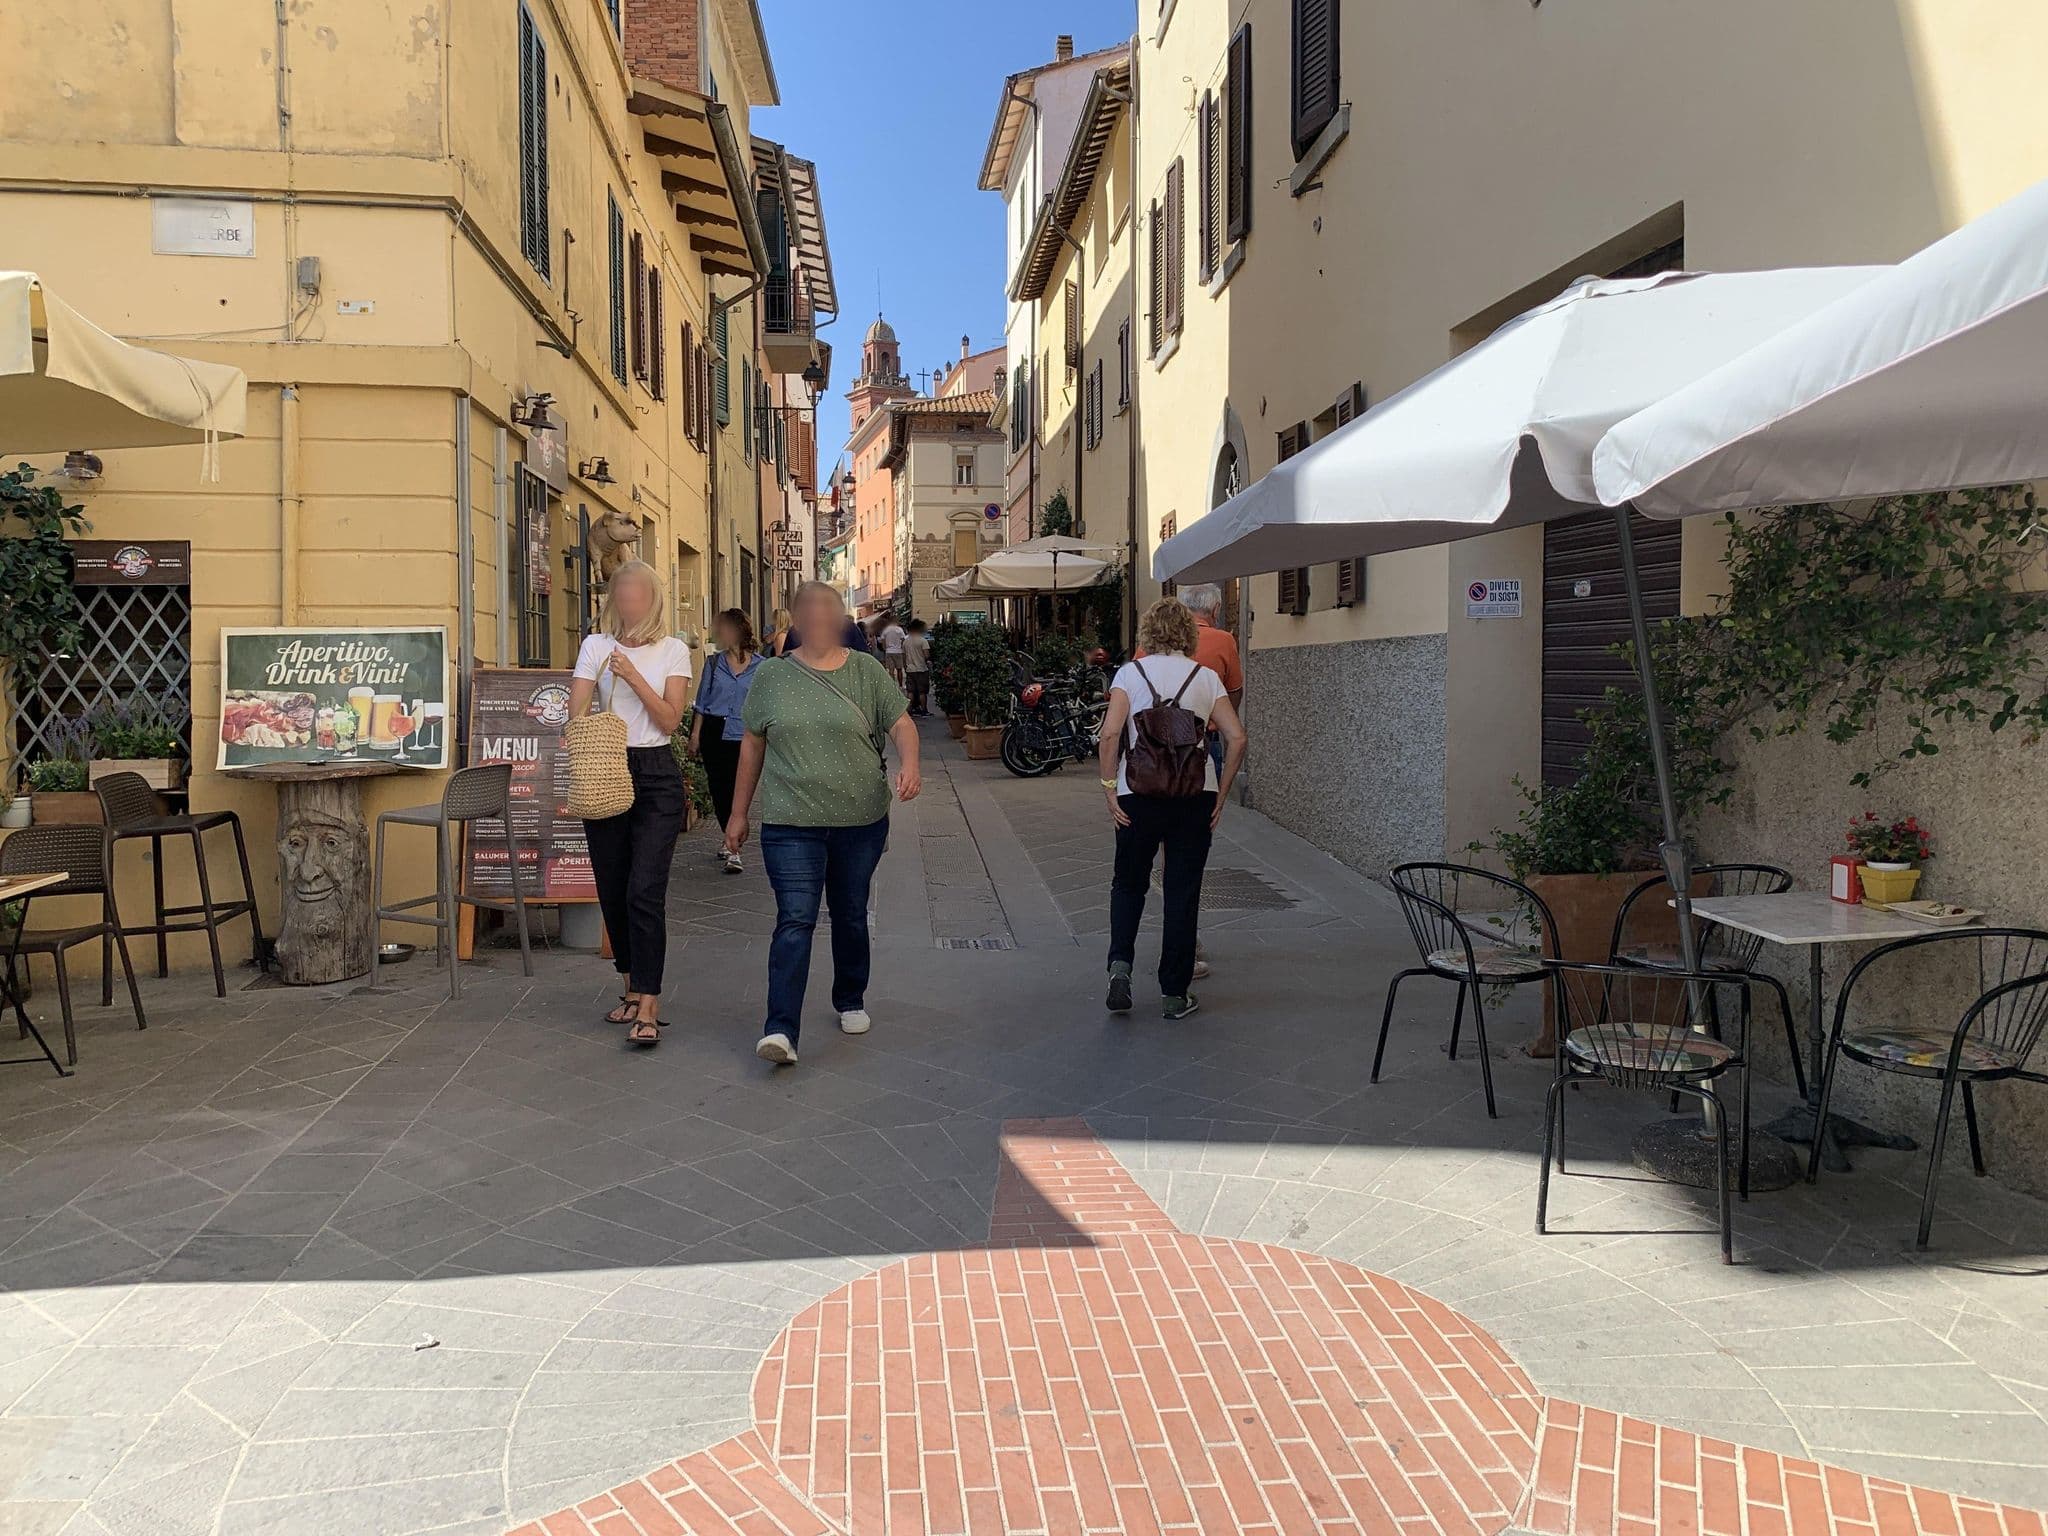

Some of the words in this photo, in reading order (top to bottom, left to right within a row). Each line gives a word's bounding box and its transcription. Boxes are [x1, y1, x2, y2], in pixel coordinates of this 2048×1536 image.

[778, 531, 802, 541] IZZA
[779, 545, 802, 556] PANE
[778, 560, 801, 570] DOLCI
[1489, 581, 1519, 591] DIVIETO
[1489, 592, 1497, 601] DI
[1498, 592, 1519, 601] SOSTA
[277, 639, 395, 669] Aperitivo,
[265, 662, 338, 685] Drink
[350, 662, 410, 685] Vini!
[482, 737, 539, 761] MENU
